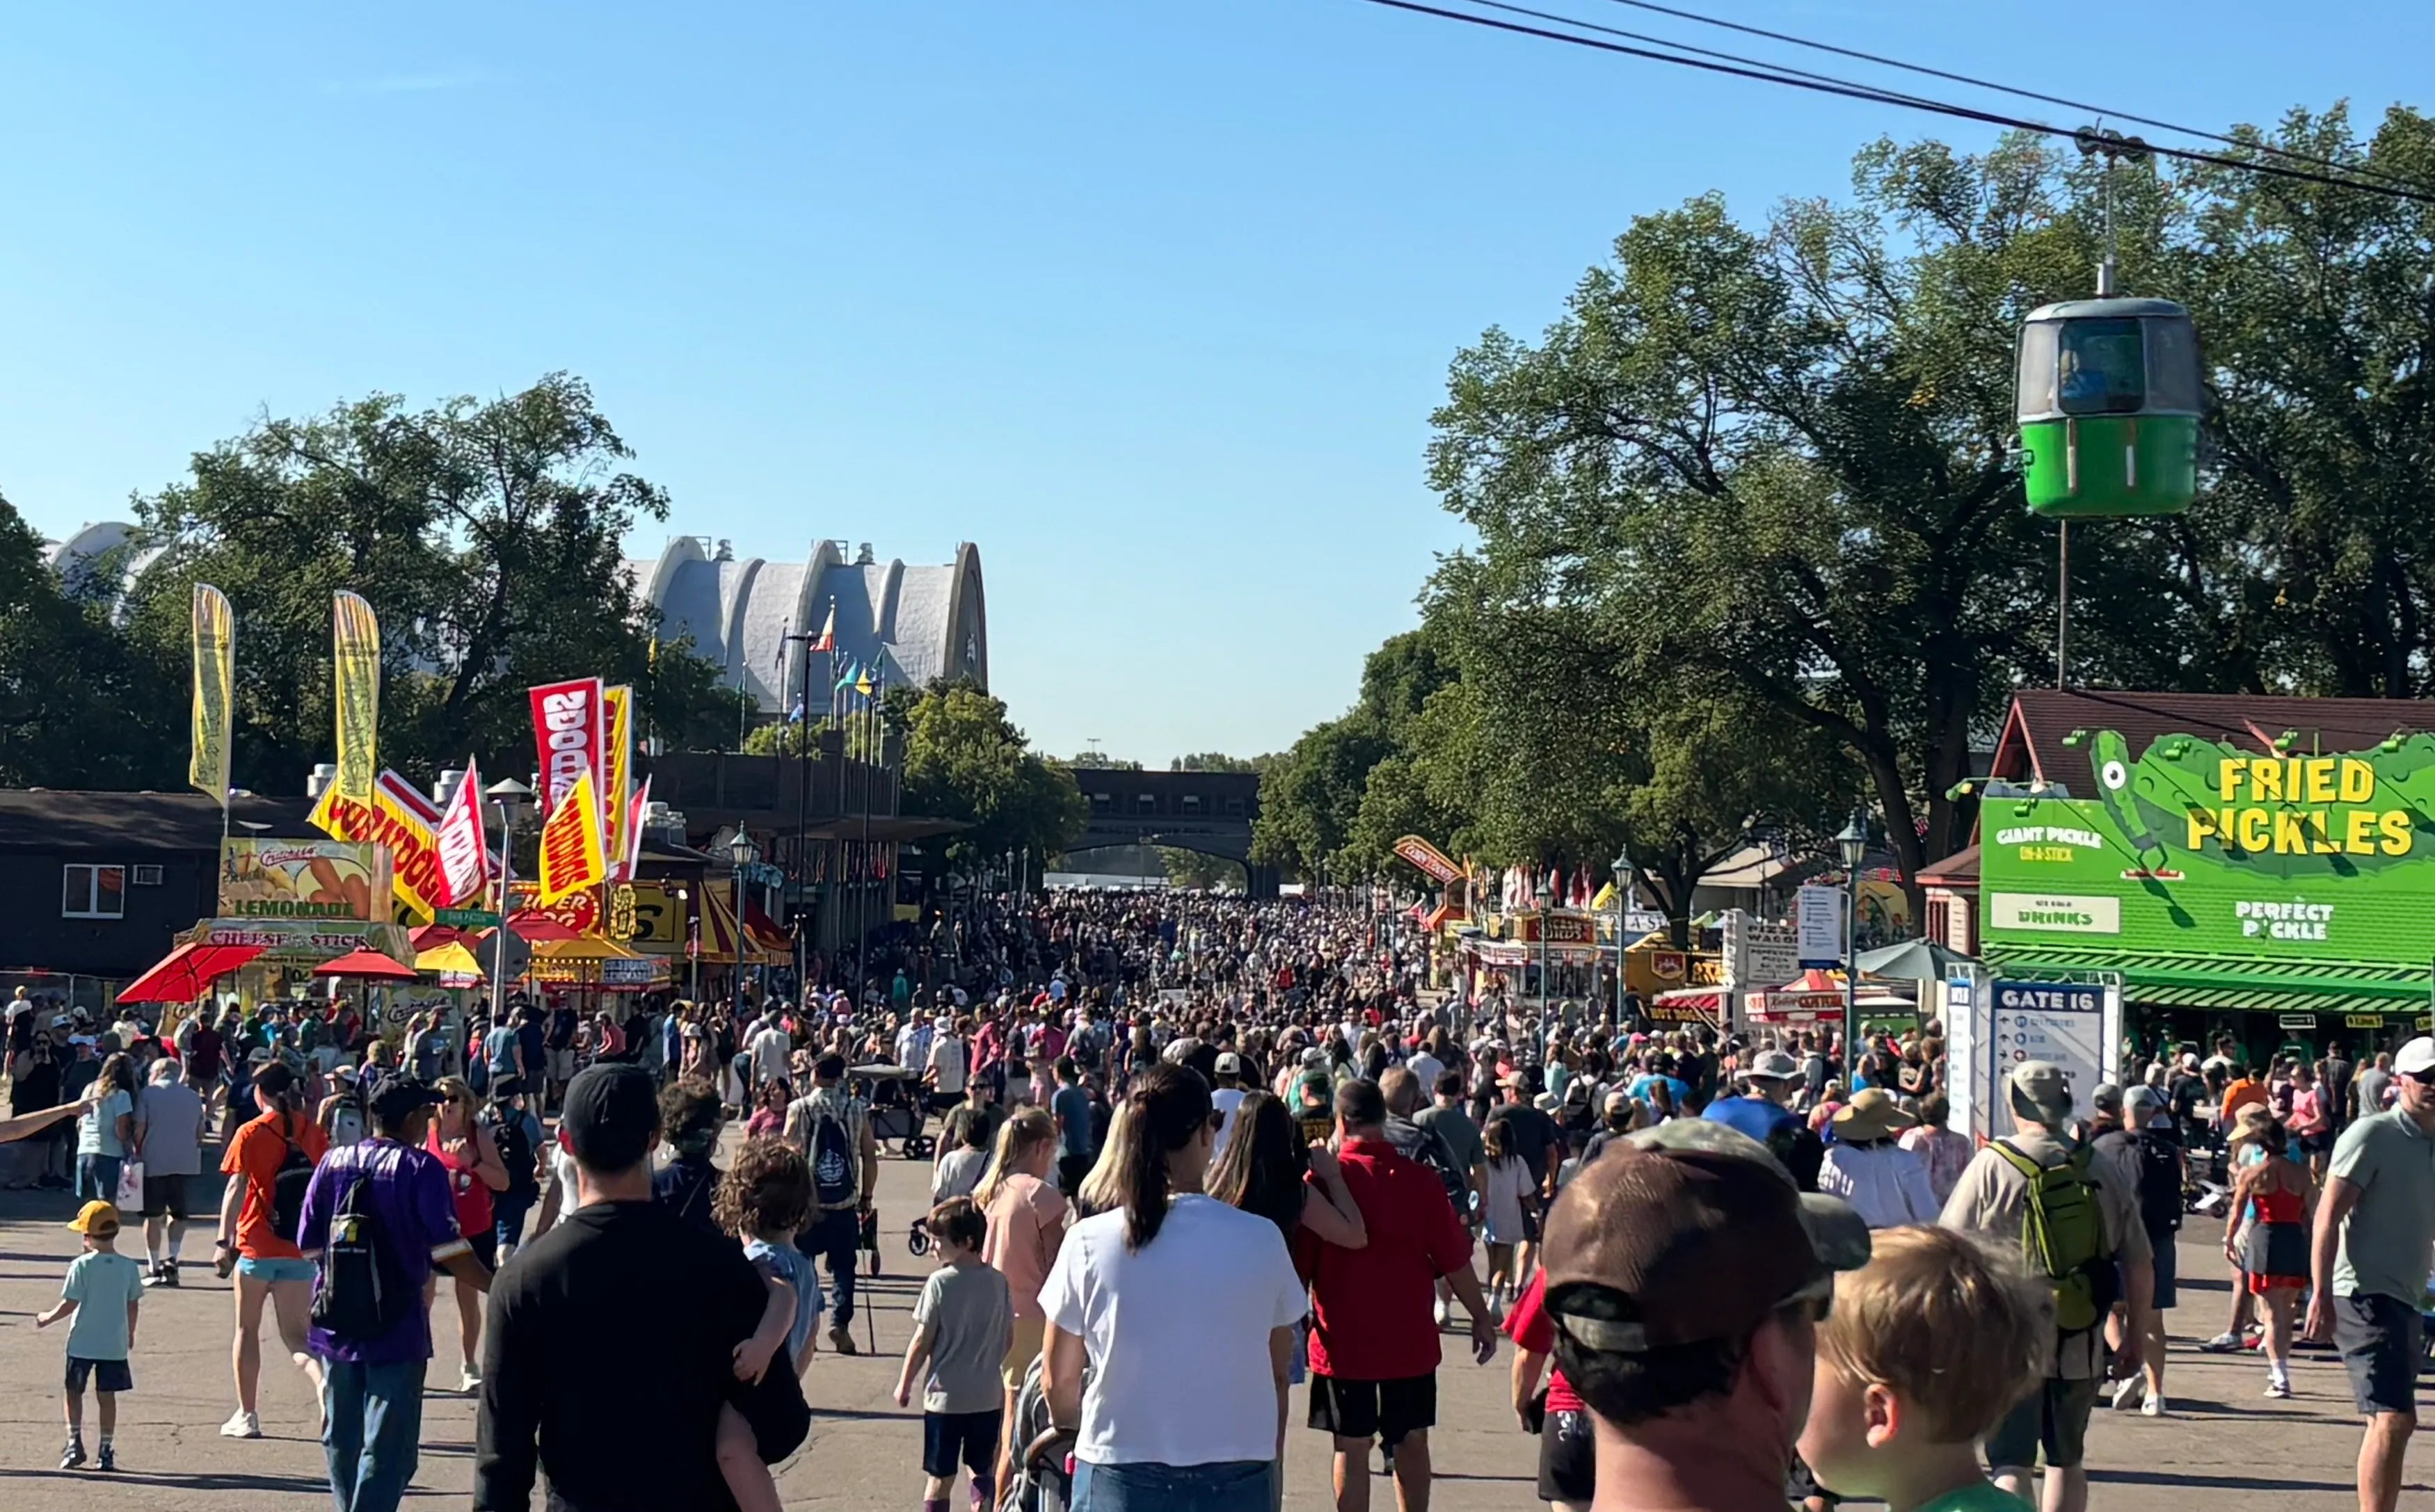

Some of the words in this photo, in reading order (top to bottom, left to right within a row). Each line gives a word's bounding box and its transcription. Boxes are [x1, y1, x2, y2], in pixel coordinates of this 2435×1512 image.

[2219, 758, 2374, 803] FRIED
[1995, 826, 2045, 845] GIANT
[2046, 826, 2102, 849] PICKLE
[2187, 807, 2413, 855] PICKLES
[2020, 846, 2073, 862] ON-A-STICK
[234, 900, 354, 917] LEMONADE
[2018, 910, 2093, 926] DRINKS
[2235, 901, 2334, 922] PERFECT
[210, 930, 286, 947] CHEESE
[310, 933, 367, 947] STICK
[2001, 990, 2064, 1009] GATE
[2070, 992, 2094, 1011] 16
